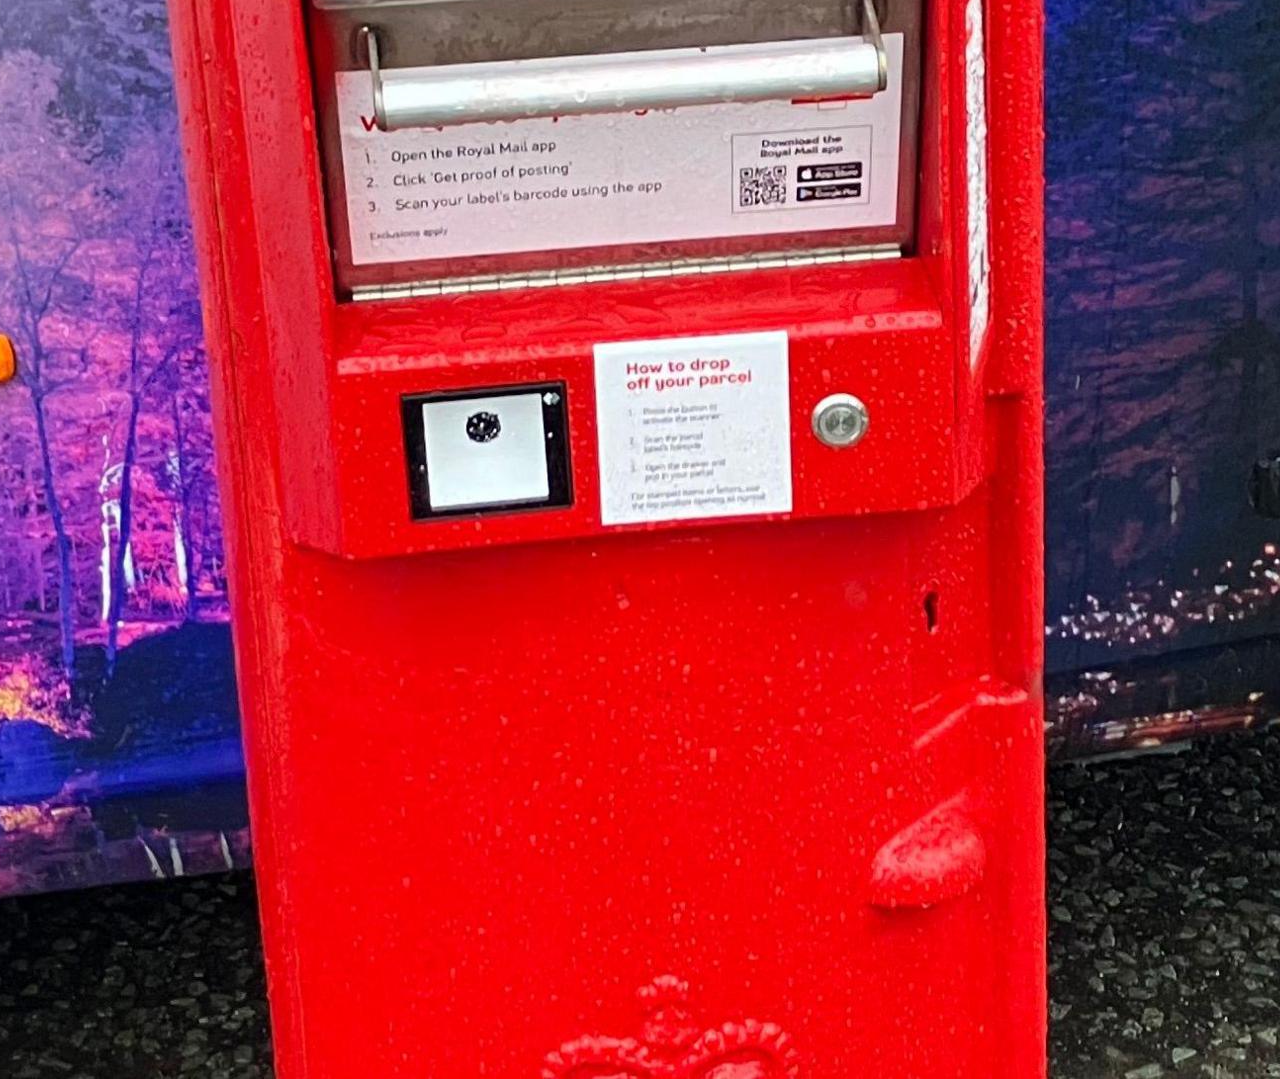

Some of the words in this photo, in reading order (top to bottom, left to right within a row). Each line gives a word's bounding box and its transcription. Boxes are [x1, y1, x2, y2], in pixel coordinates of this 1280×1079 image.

[391, 150, 428, 165] Open
[431, 147, 453, 160] the
[457, 143, 495, 161] Royal
[499, 140, 528, 155] Mail
[531, 140, 557, 155] app
[760, 147, 792, 159] Royal
[794, 146, 819, 157] Mail
[821, 145, 844, 156] app
[761, 135, 820, 149] Download
[822, 134, 843, 145] the
[393, 172, 426, 187] Click
[461, 168, 498, 185] proof
[501, 165, 515, 179] of
[395, 198, 429, 212] Scan
[432, 195, 464, 211] your
[466, 190, 510, 206] label's
[513, 185, 568, 202] barcode
[571, 183, 609, 199] using
[612, 180, 634, 194] the
[637, 180, 663, 195] app
[626, 362, 663, 375] How
[668, 360, 685, 373] to
[690, 357, 730, 372] drop
[626, 376, 650, 391] off
[654, 376, 695, 392] your
[699, 369, 752, 389] parcel
